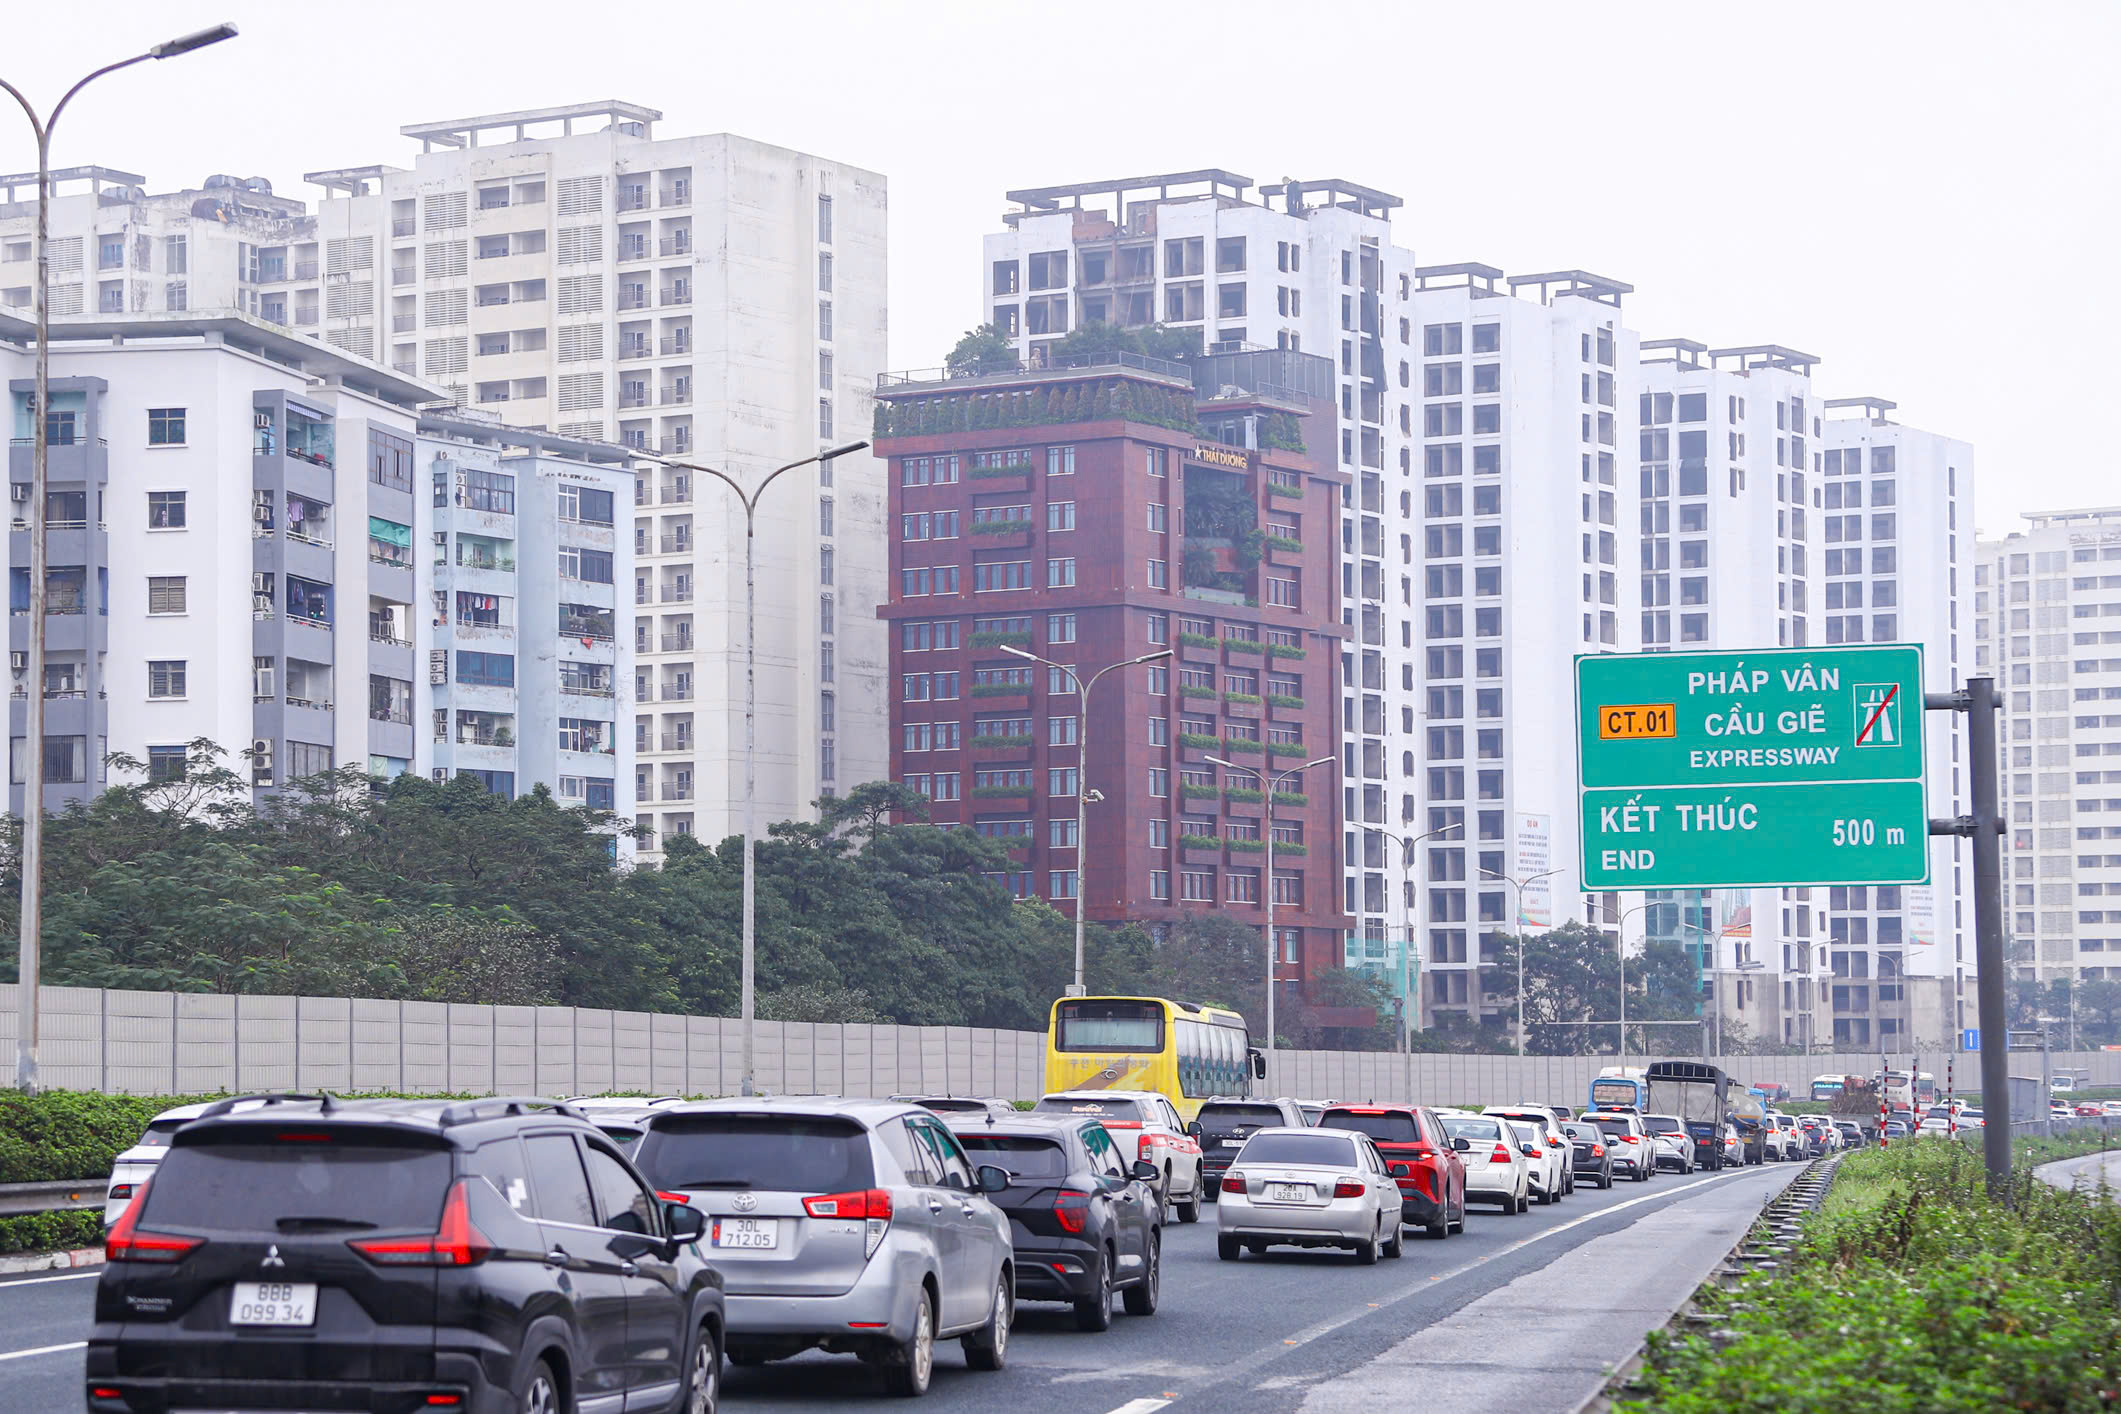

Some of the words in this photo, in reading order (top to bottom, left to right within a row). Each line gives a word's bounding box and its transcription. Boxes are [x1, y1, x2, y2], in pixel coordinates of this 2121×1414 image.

[1203, 447, 1219, 464] THÁI
[1688, 661, 1769, 695] PHÁP
[1780, 662, 1840, 692] VÂN
[1608, 709, 1667, 733] CT.01
[1704, 702, 1765, 737] CẦU
[1777, 703, 1826, 734] GIẼ
[1690, 746, 1840, 768] EXPRESSWAY
[1600, 793, 1661, 833] KẾT
[1675, 796, 1759, 831] THÚC
[1832, 818, 1875, 847] 500
[1886, 827, 1905, 845] m
[1601, 849, 1655, 871] END
[737, 1220, 760, 1233] 30L
[726, 1233, 771, 1246] 712.05
[240, 1303, 305, 1321] 099.34
